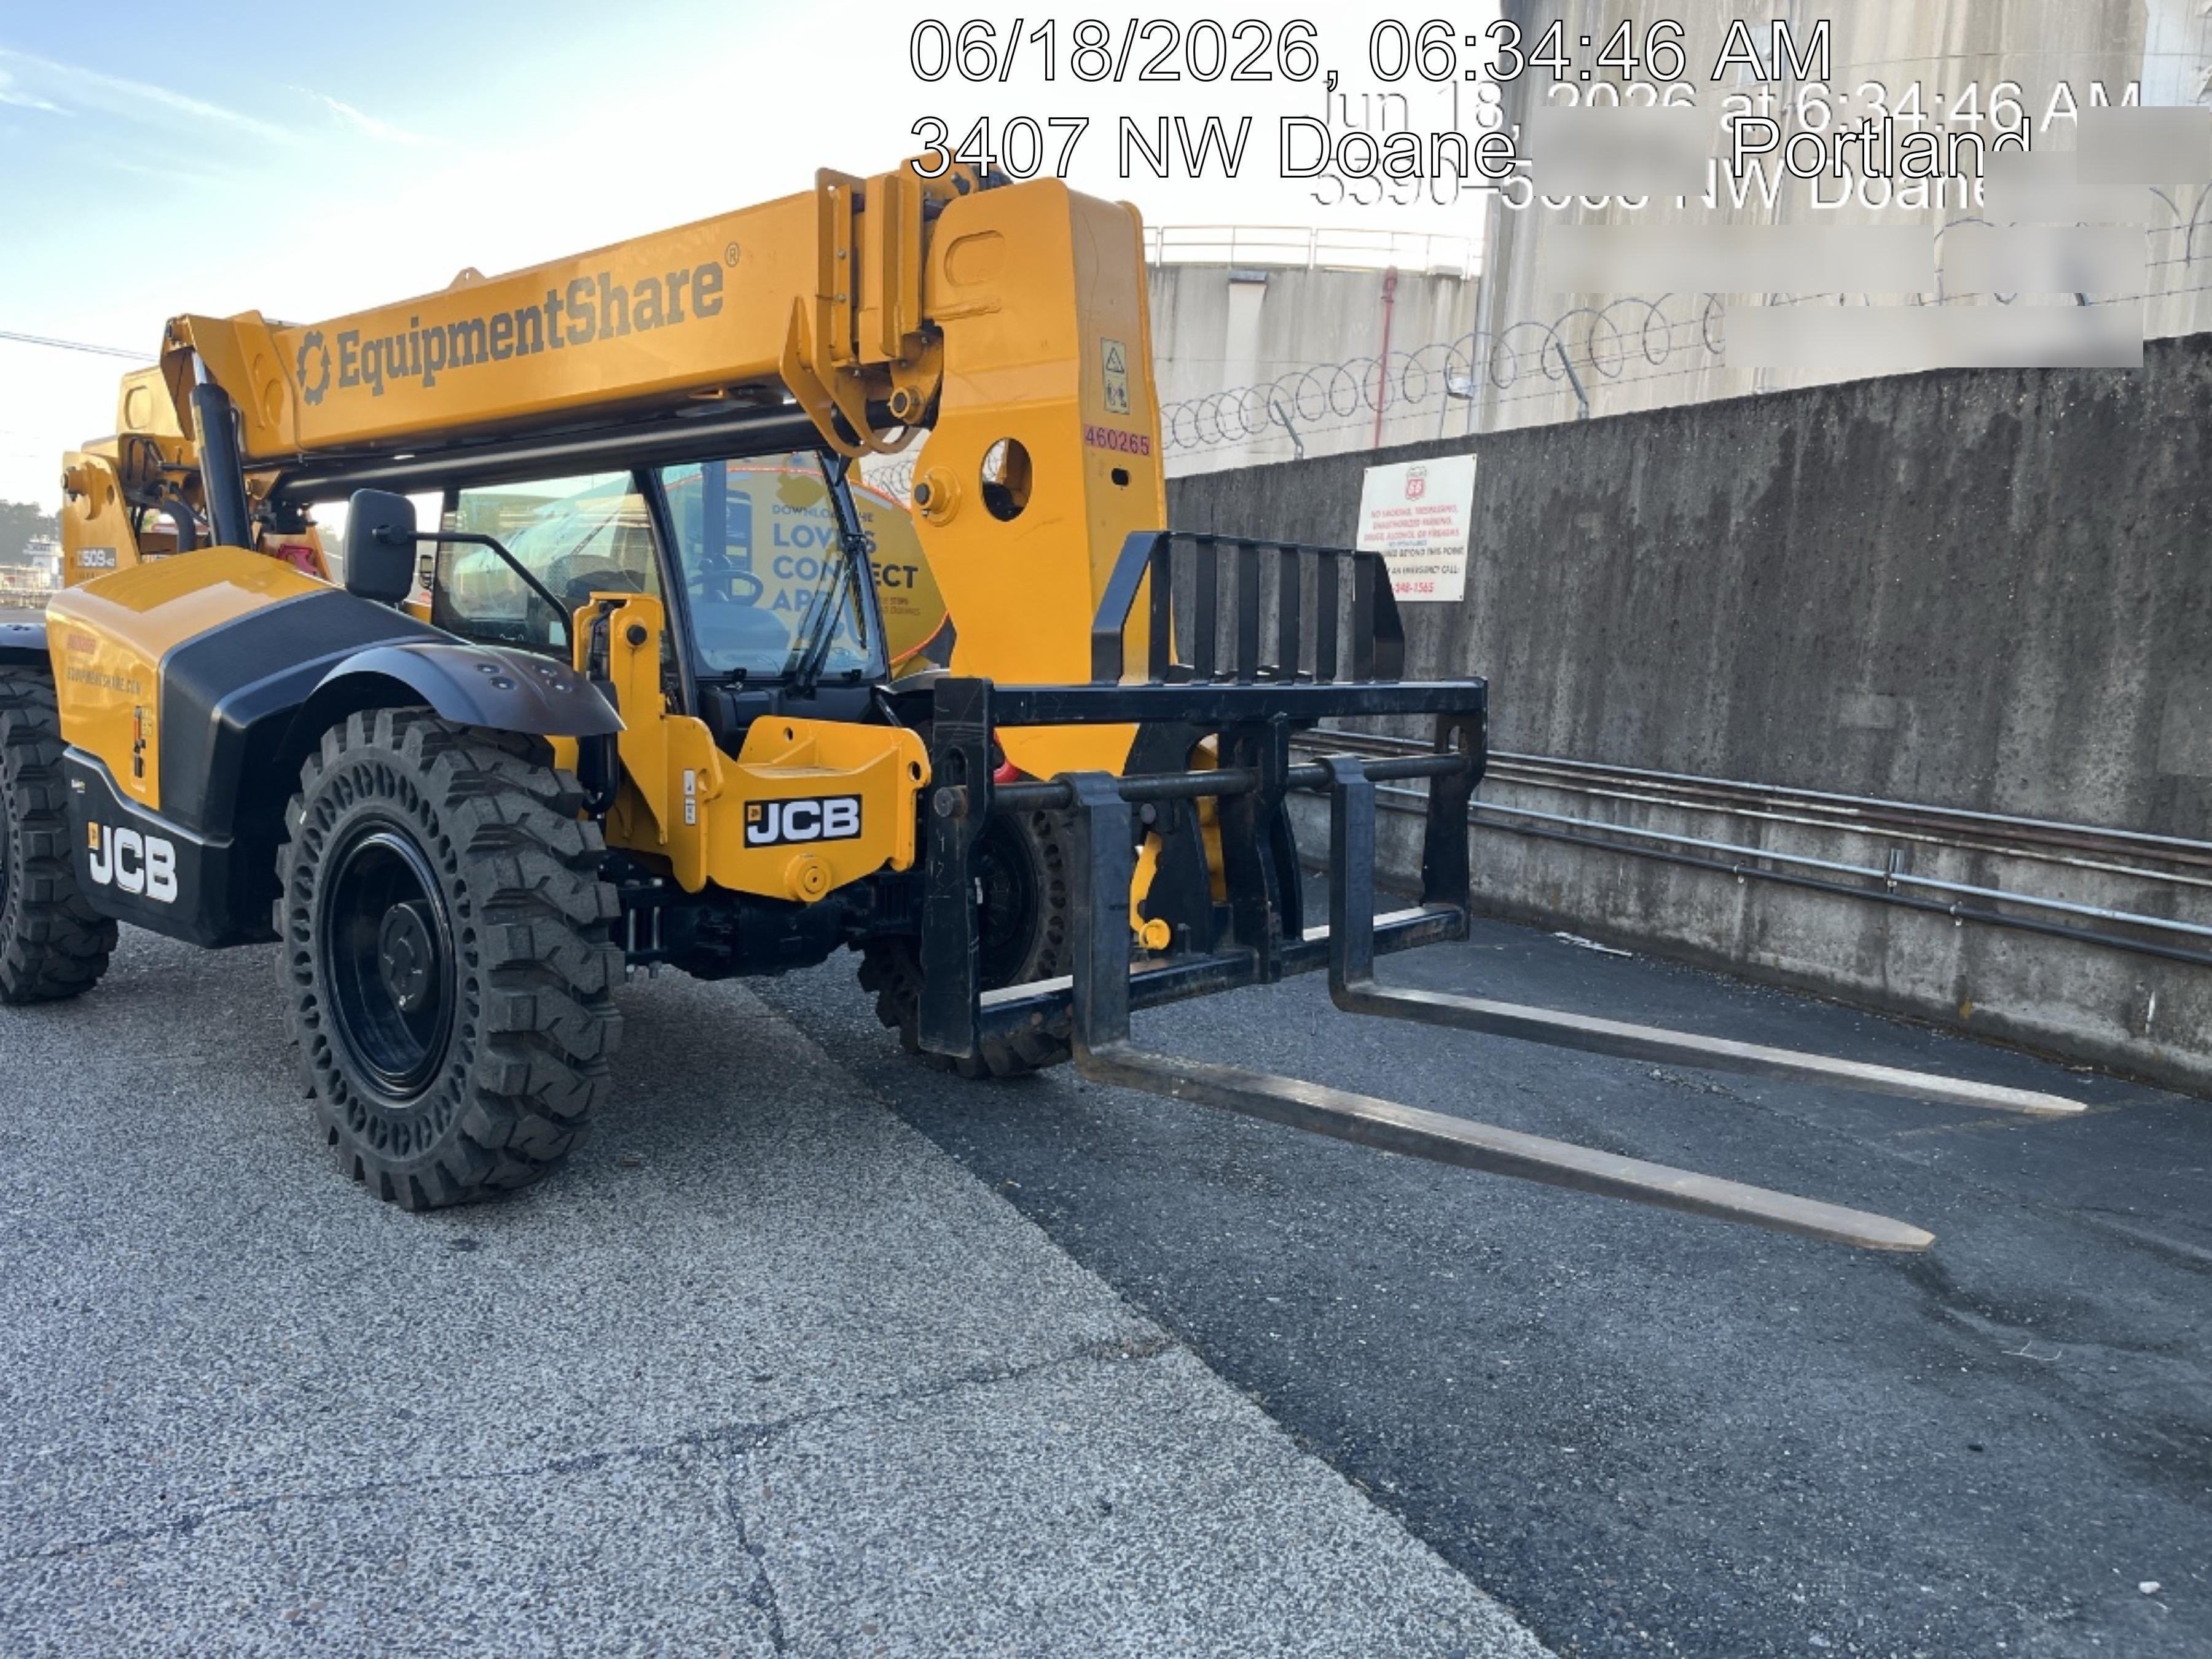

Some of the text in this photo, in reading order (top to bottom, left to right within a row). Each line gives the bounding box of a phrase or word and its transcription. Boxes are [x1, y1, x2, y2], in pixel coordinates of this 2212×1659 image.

[1085, 426, 1150, 455] 460265
[772, 505, 837, 519] DOWNLO
[747, 798, 860, 844] JCB
[89, 825, 178, 904] JCB
